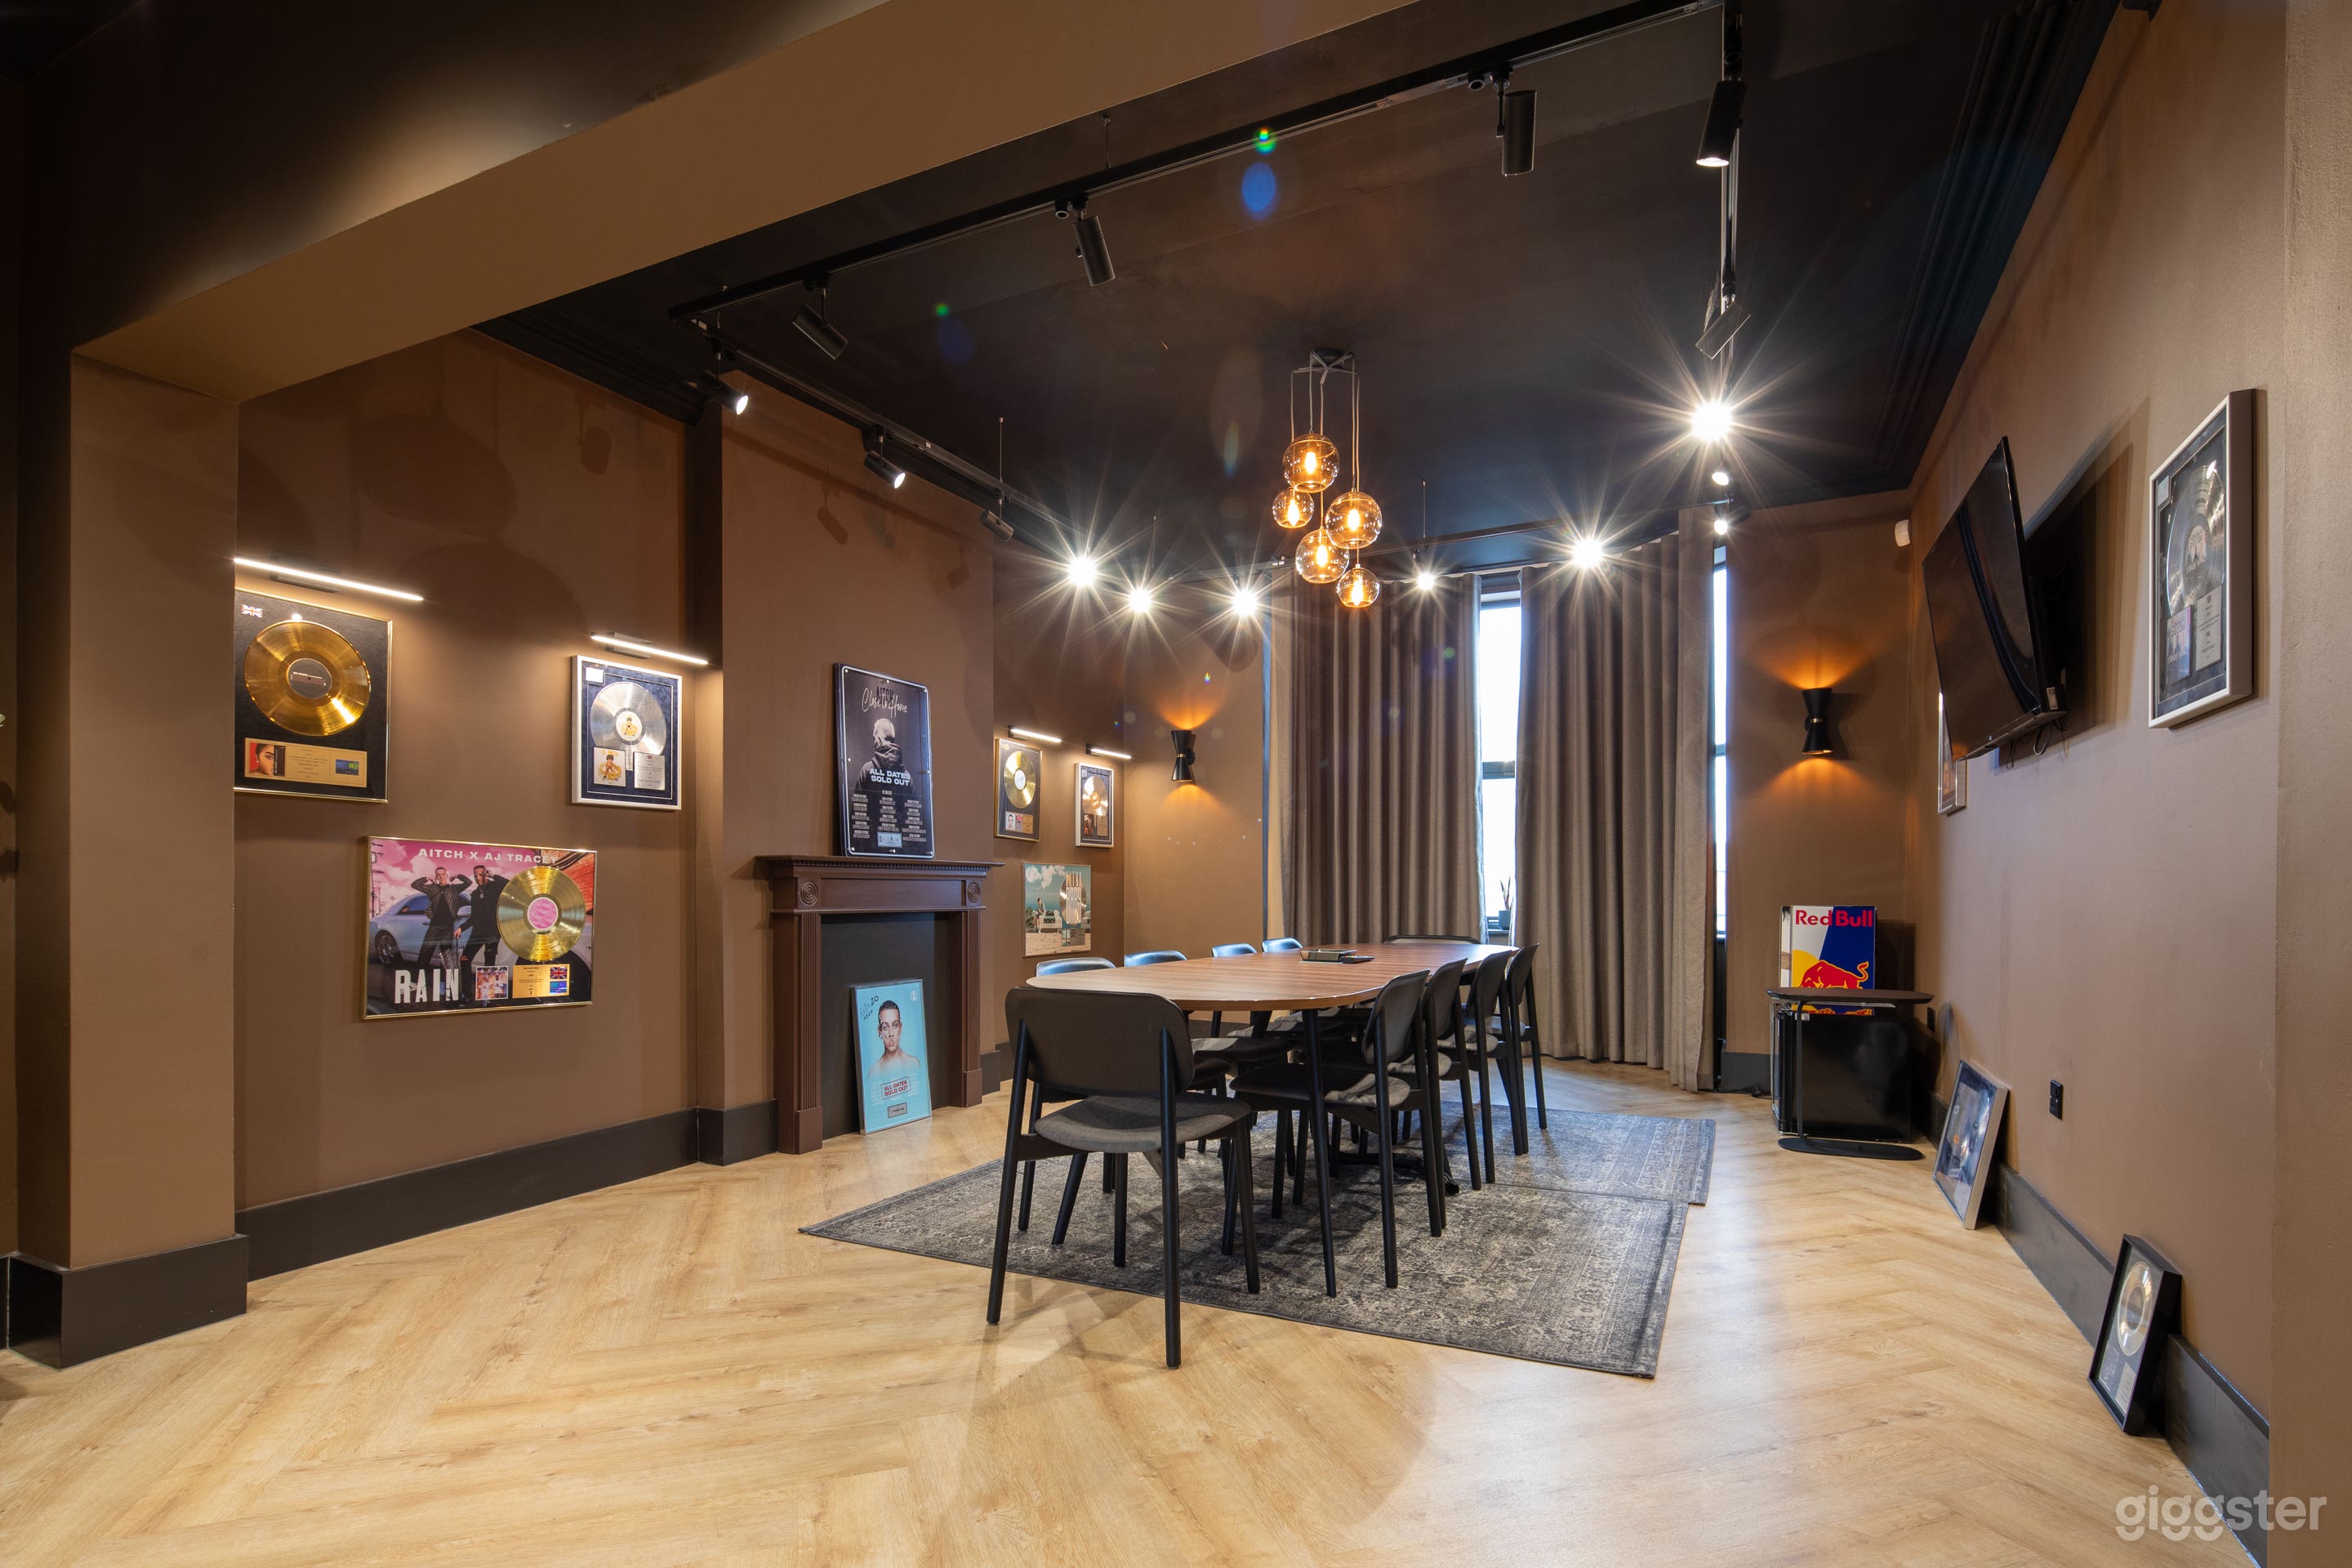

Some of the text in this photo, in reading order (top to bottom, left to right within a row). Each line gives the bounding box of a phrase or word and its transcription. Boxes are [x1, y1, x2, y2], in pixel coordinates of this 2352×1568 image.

[871, 775, 892, 783] SOLD
[887, 770, 911, 780] DATES
[418, 849, 463, 858] AITCH
[484, 853, 501, 861] AJ
[507, 853, 557, 863] TRACEY
[1796, 910, 1873, 927] Red Bull
[394, 969, 459, 1004] RAIN
